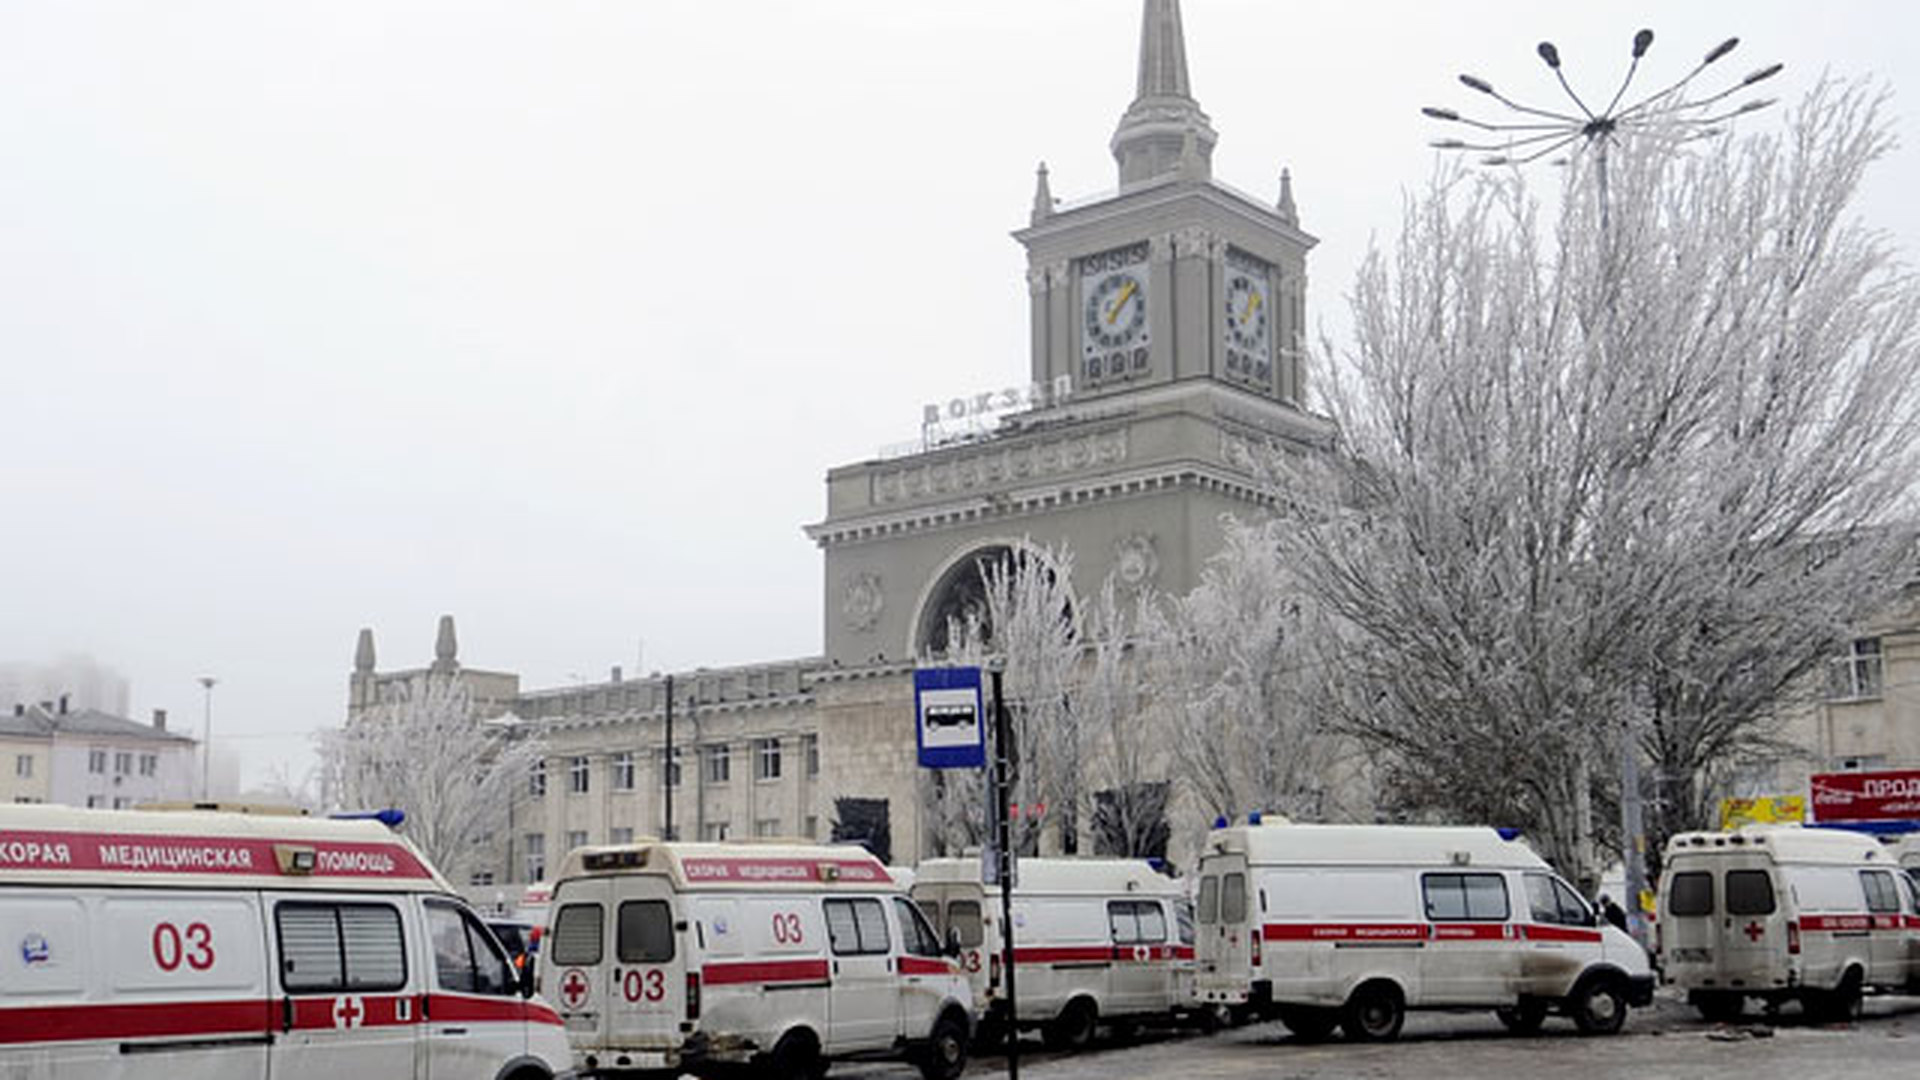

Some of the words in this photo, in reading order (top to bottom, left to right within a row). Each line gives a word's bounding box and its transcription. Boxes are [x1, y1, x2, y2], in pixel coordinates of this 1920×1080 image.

[100, 845, 253, 869] МЕДИЦИНСКАЯ
[318, 851, 395, 874] ПОМОЩЬ
[773, 913, 802, 943] 03
[153, 922, 215, 971] 03
[624, 969, 665, 1002] 03
